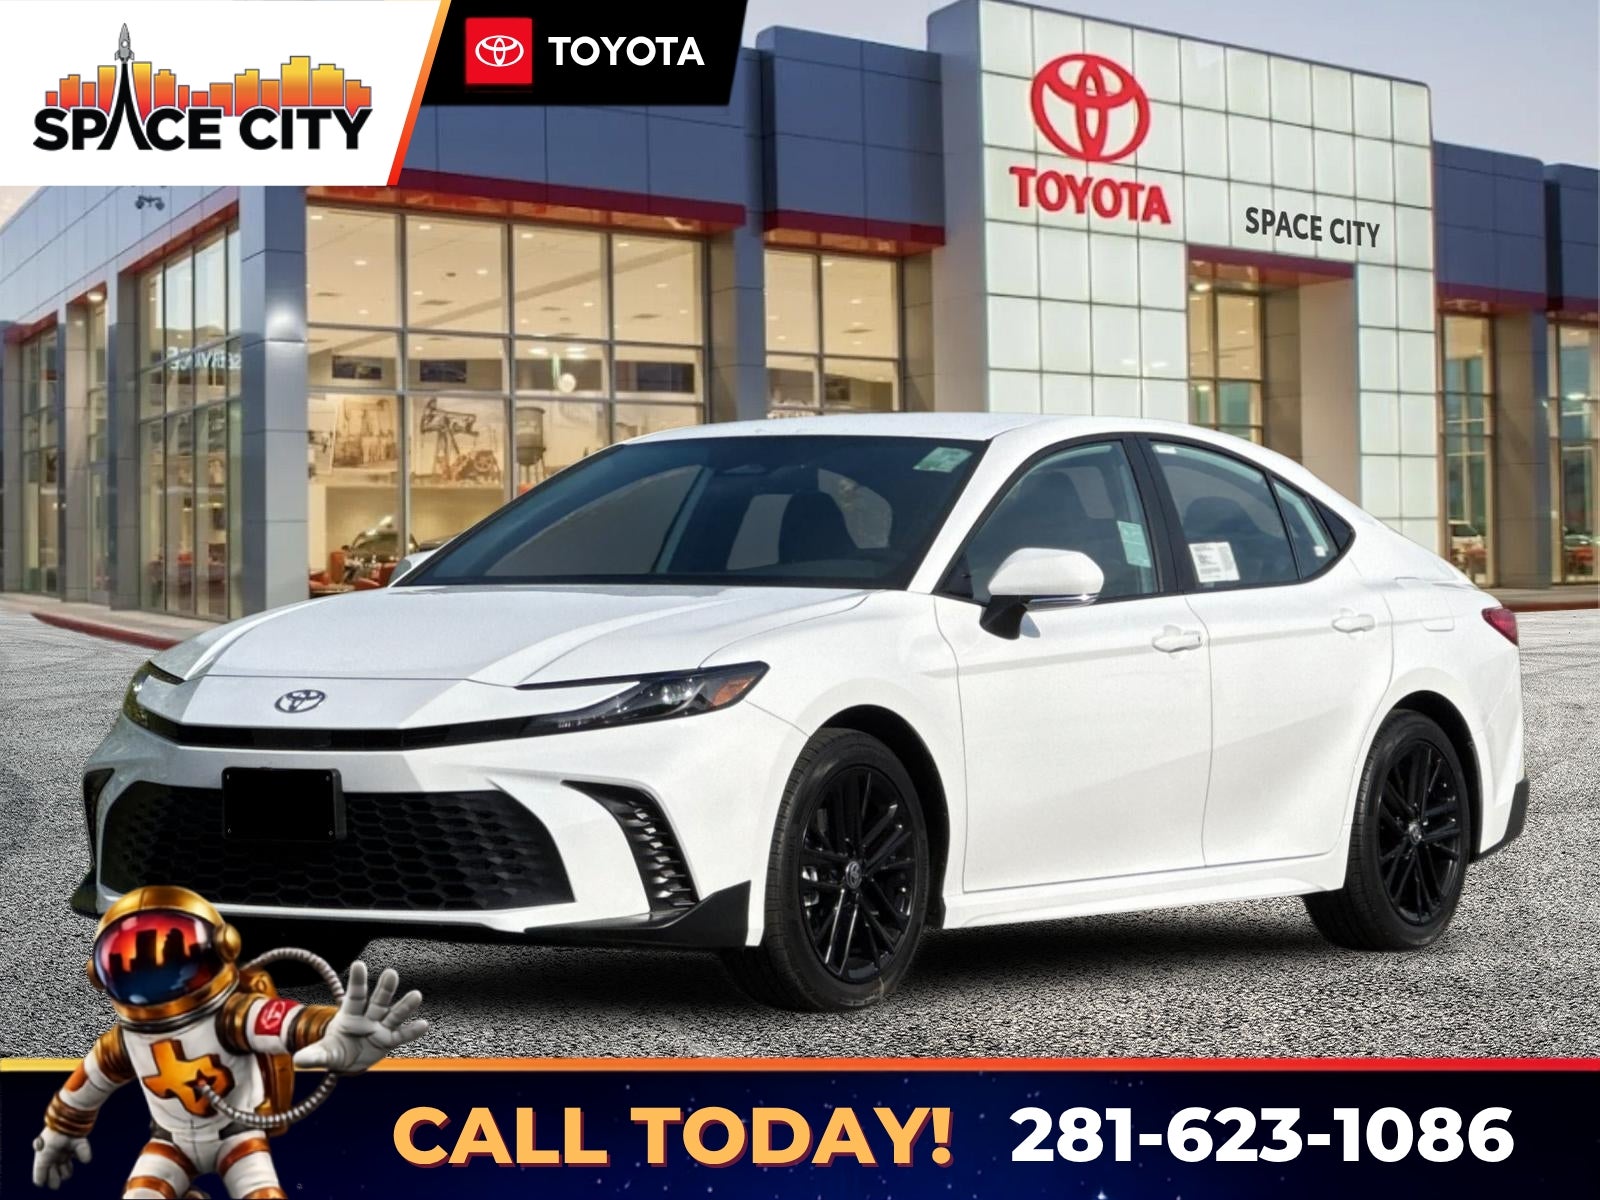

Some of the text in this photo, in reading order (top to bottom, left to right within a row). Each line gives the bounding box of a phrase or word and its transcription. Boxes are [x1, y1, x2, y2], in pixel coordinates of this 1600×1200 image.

[1009, 165, 1172, 225] TOYOTA
[1245, 206, 1381, 249] SPACE CITY
